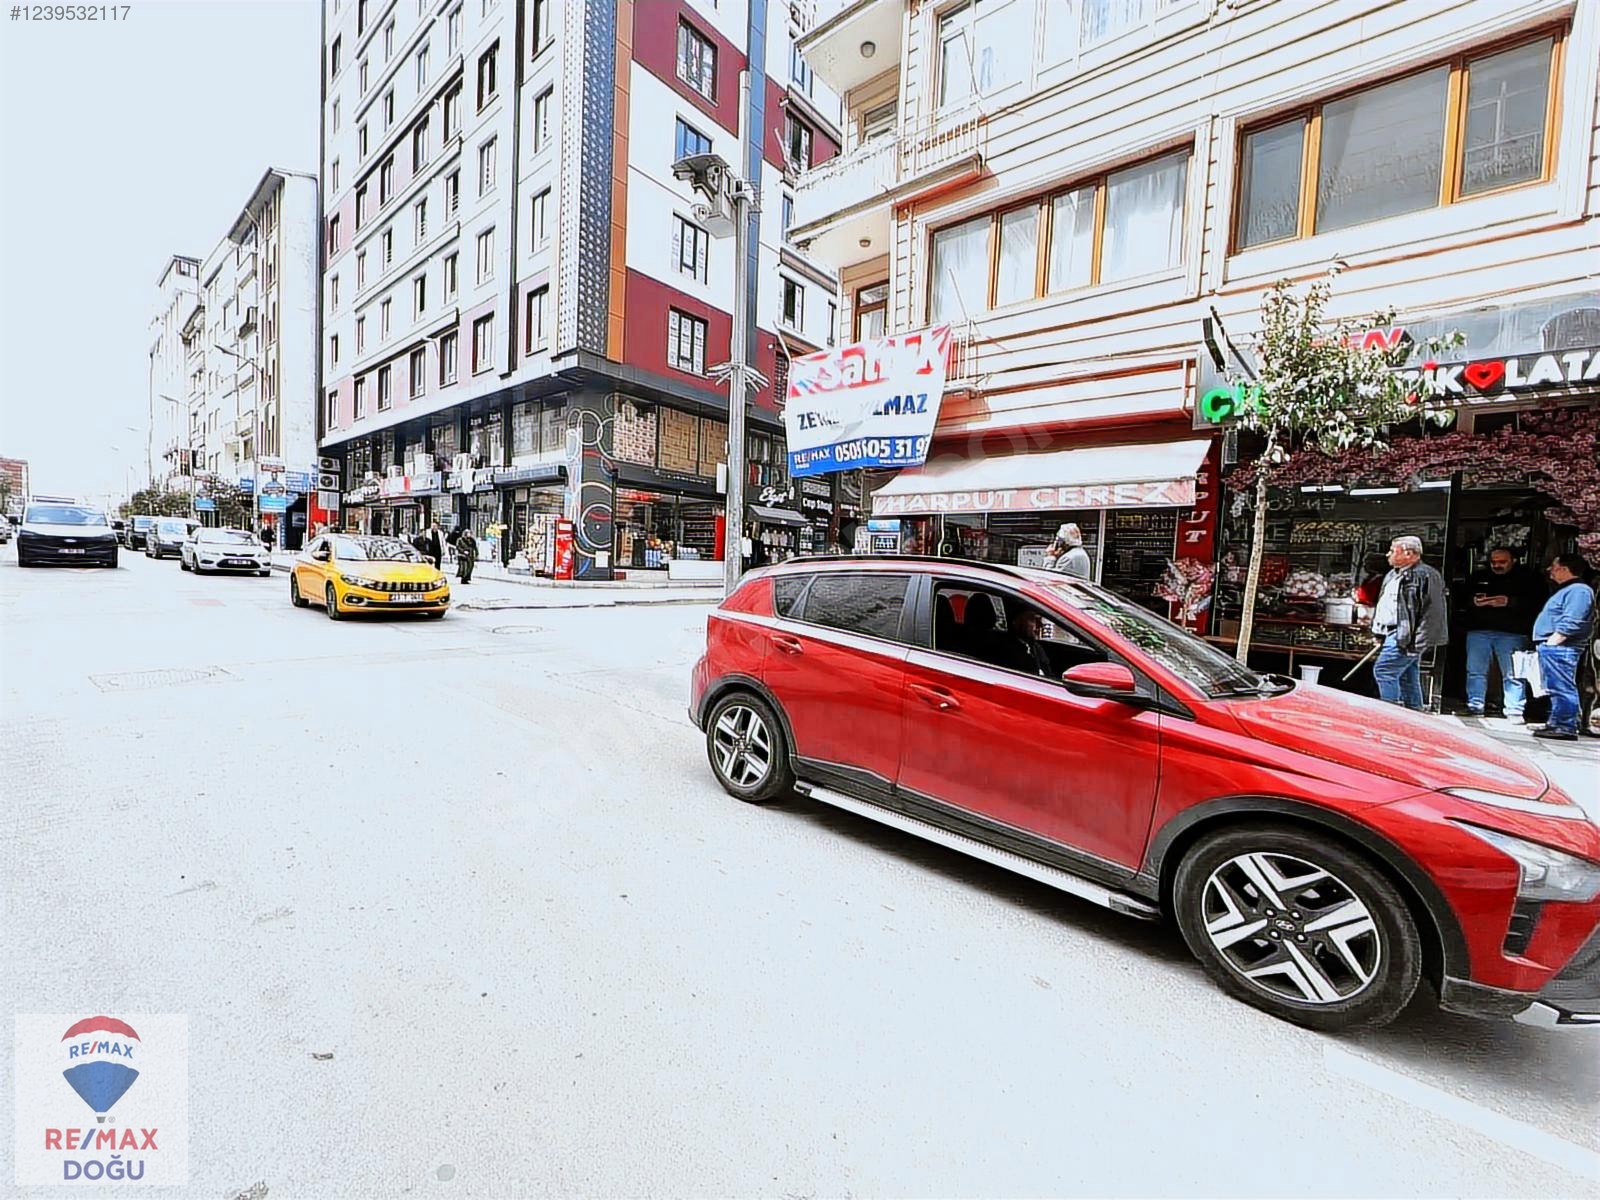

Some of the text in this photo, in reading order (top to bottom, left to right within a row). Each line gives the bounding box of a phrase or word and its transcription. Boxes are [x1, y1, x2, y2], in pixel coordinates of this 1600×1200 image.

[860, 393, 928, 416] LMAZ
[794, 448, 831, 464] RE/MAX
[894, 438, 912, 458] 31
[882, 490, 1018, 512] HARPUT
